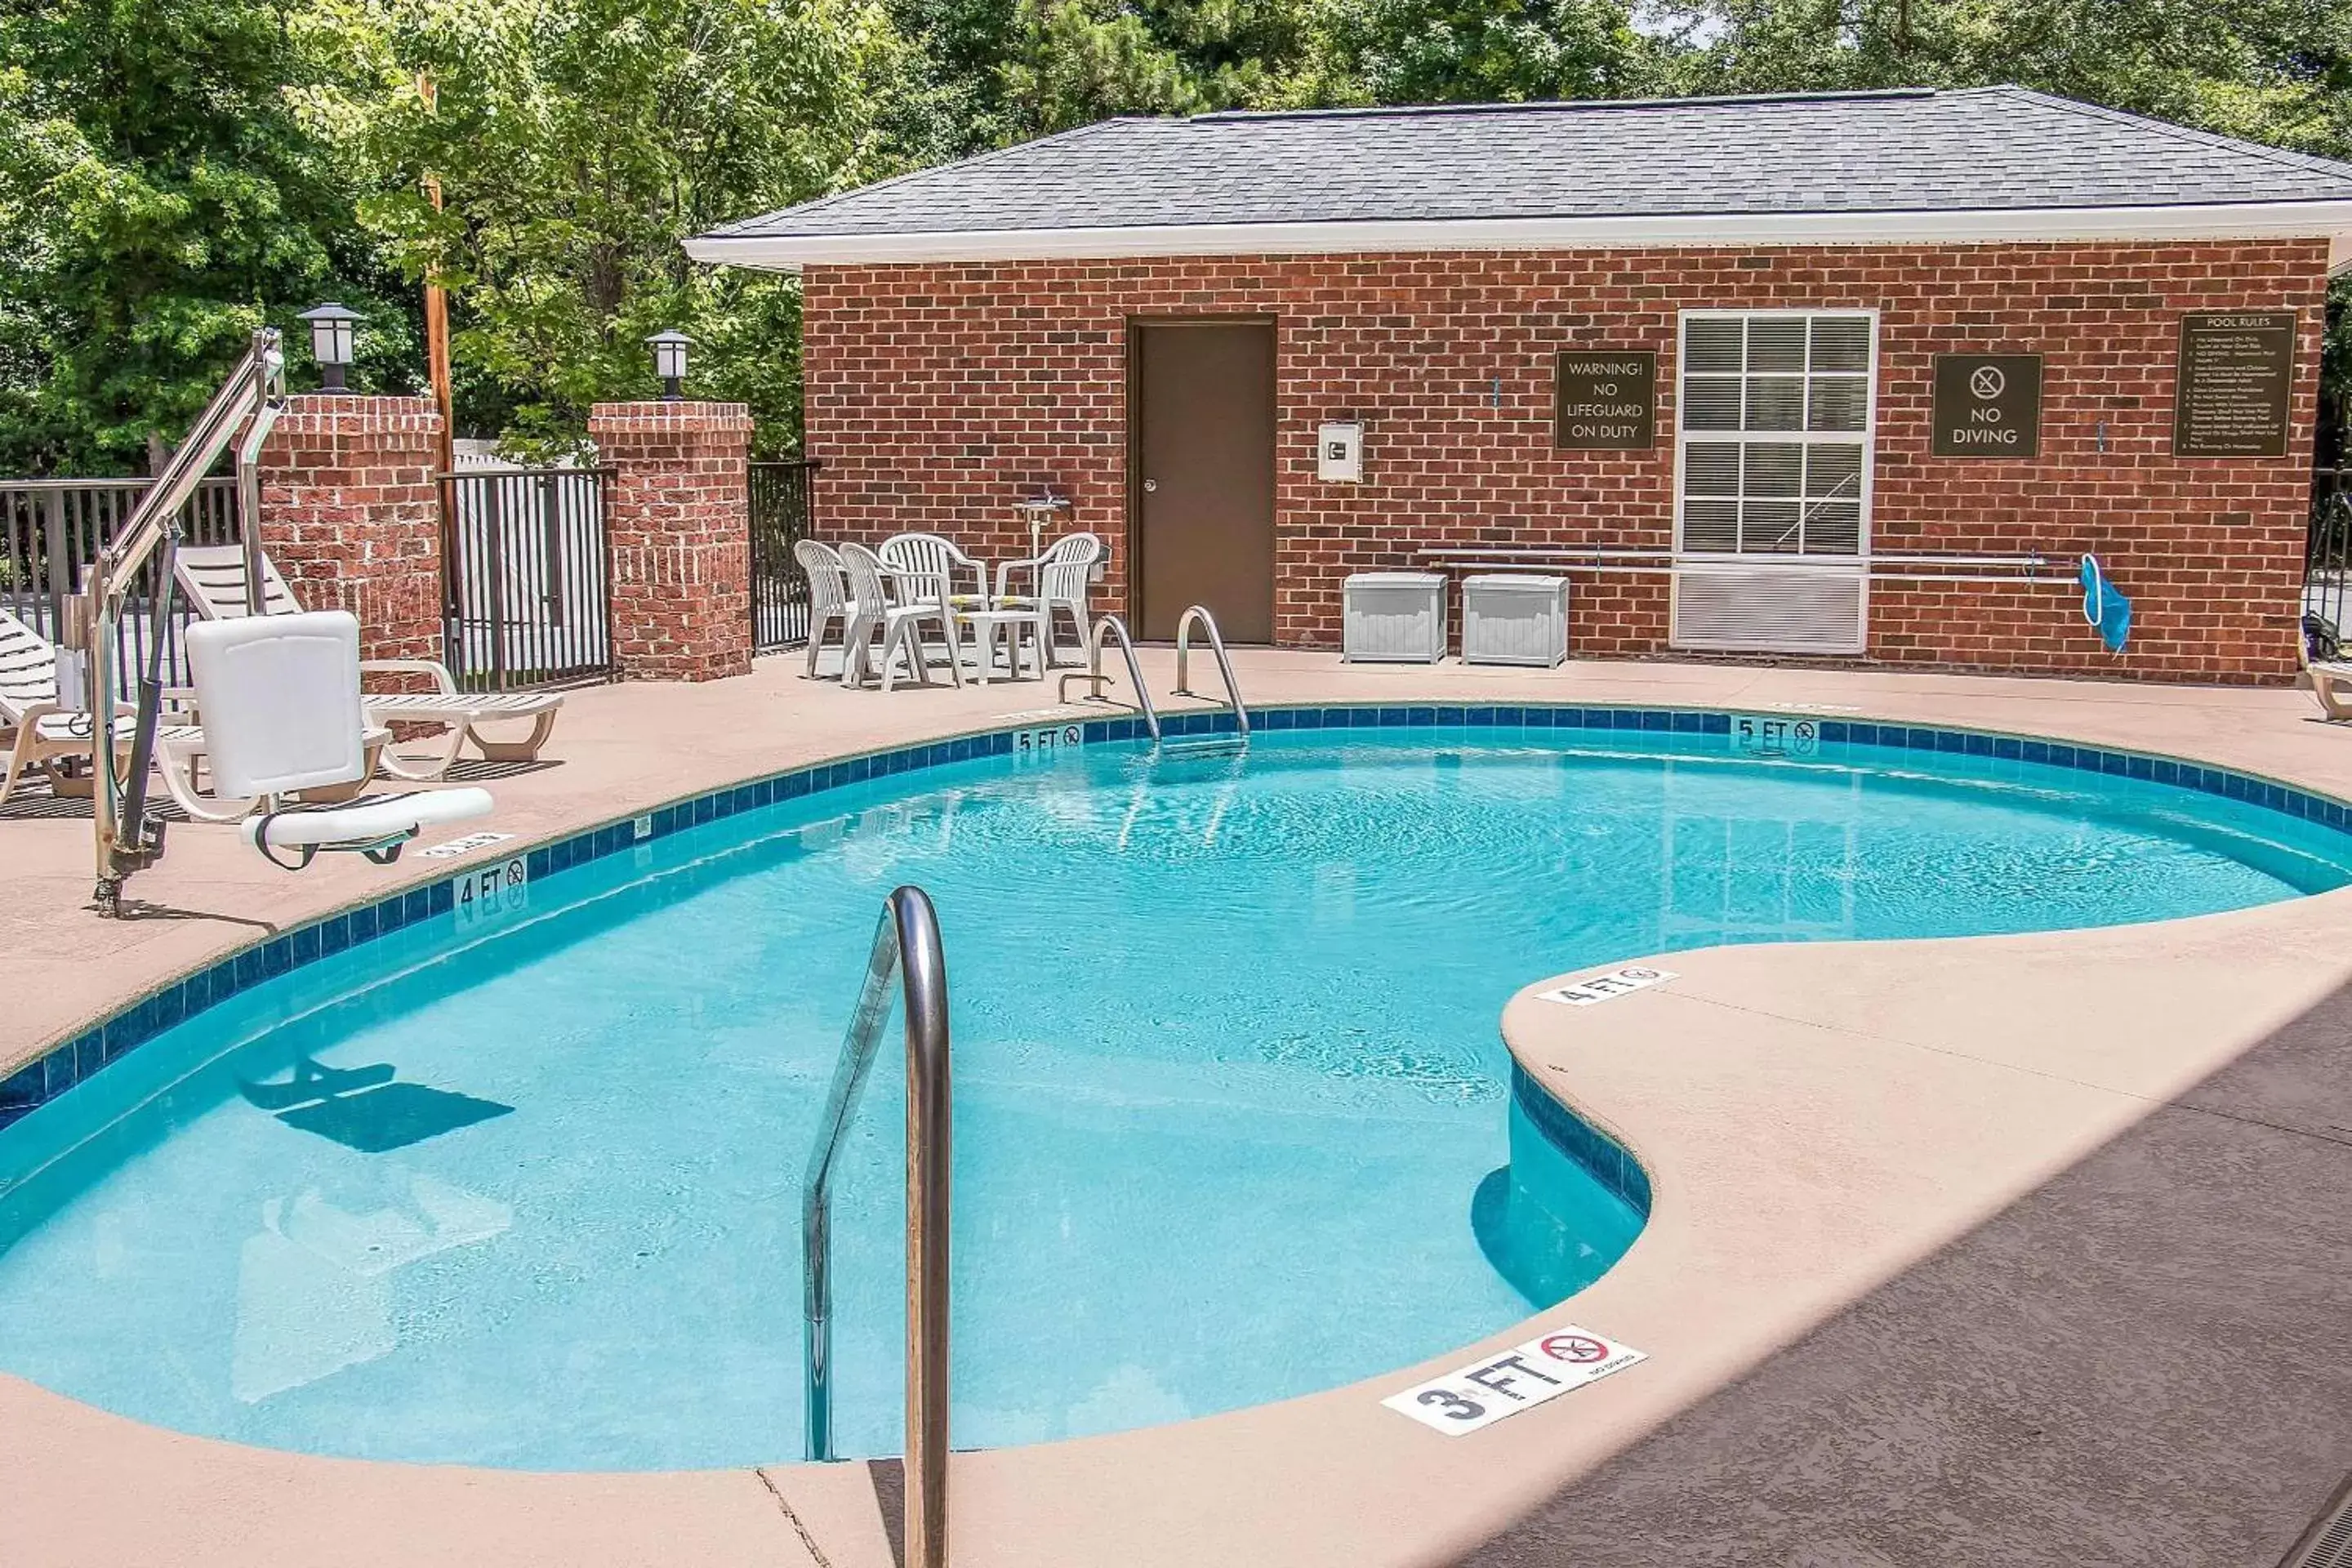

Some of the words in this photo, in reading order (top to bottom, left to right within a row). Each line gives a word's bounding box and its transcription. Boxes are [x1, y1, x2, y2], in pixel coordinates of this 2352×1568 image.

[2207, 318, 2237, 327] POOL
[2239, 317, 2270, 327] RULES
[1569, 363, 1643, 376] WARNING!
[1593, 383, 1618, 396] NO
[1567, 403, 1643, 417] LIFEGUARD
[1971, 408, 2002, 422] NO
[1571, 424, 1596, 438] ON
[1601, 425, 1637, 439] DUTY
[1953, 429, 2018, 444] DIVING
[1740, 719, 1754, 735] 5
[1763, 721, 1787, 737] FT
[1019, 733, 1031, 751] 5
[1038, 730, 1058, 748] FT
[461, 878, 474, 904] 4
[481, 868, 501, 898] FT
[1559, 991, 1597, 1001] 4
[1580, 978, 1636, 994] FT
[1417, 1389, 1486, 1420] 3
[1464, 1355, 1562, 1401] FT
